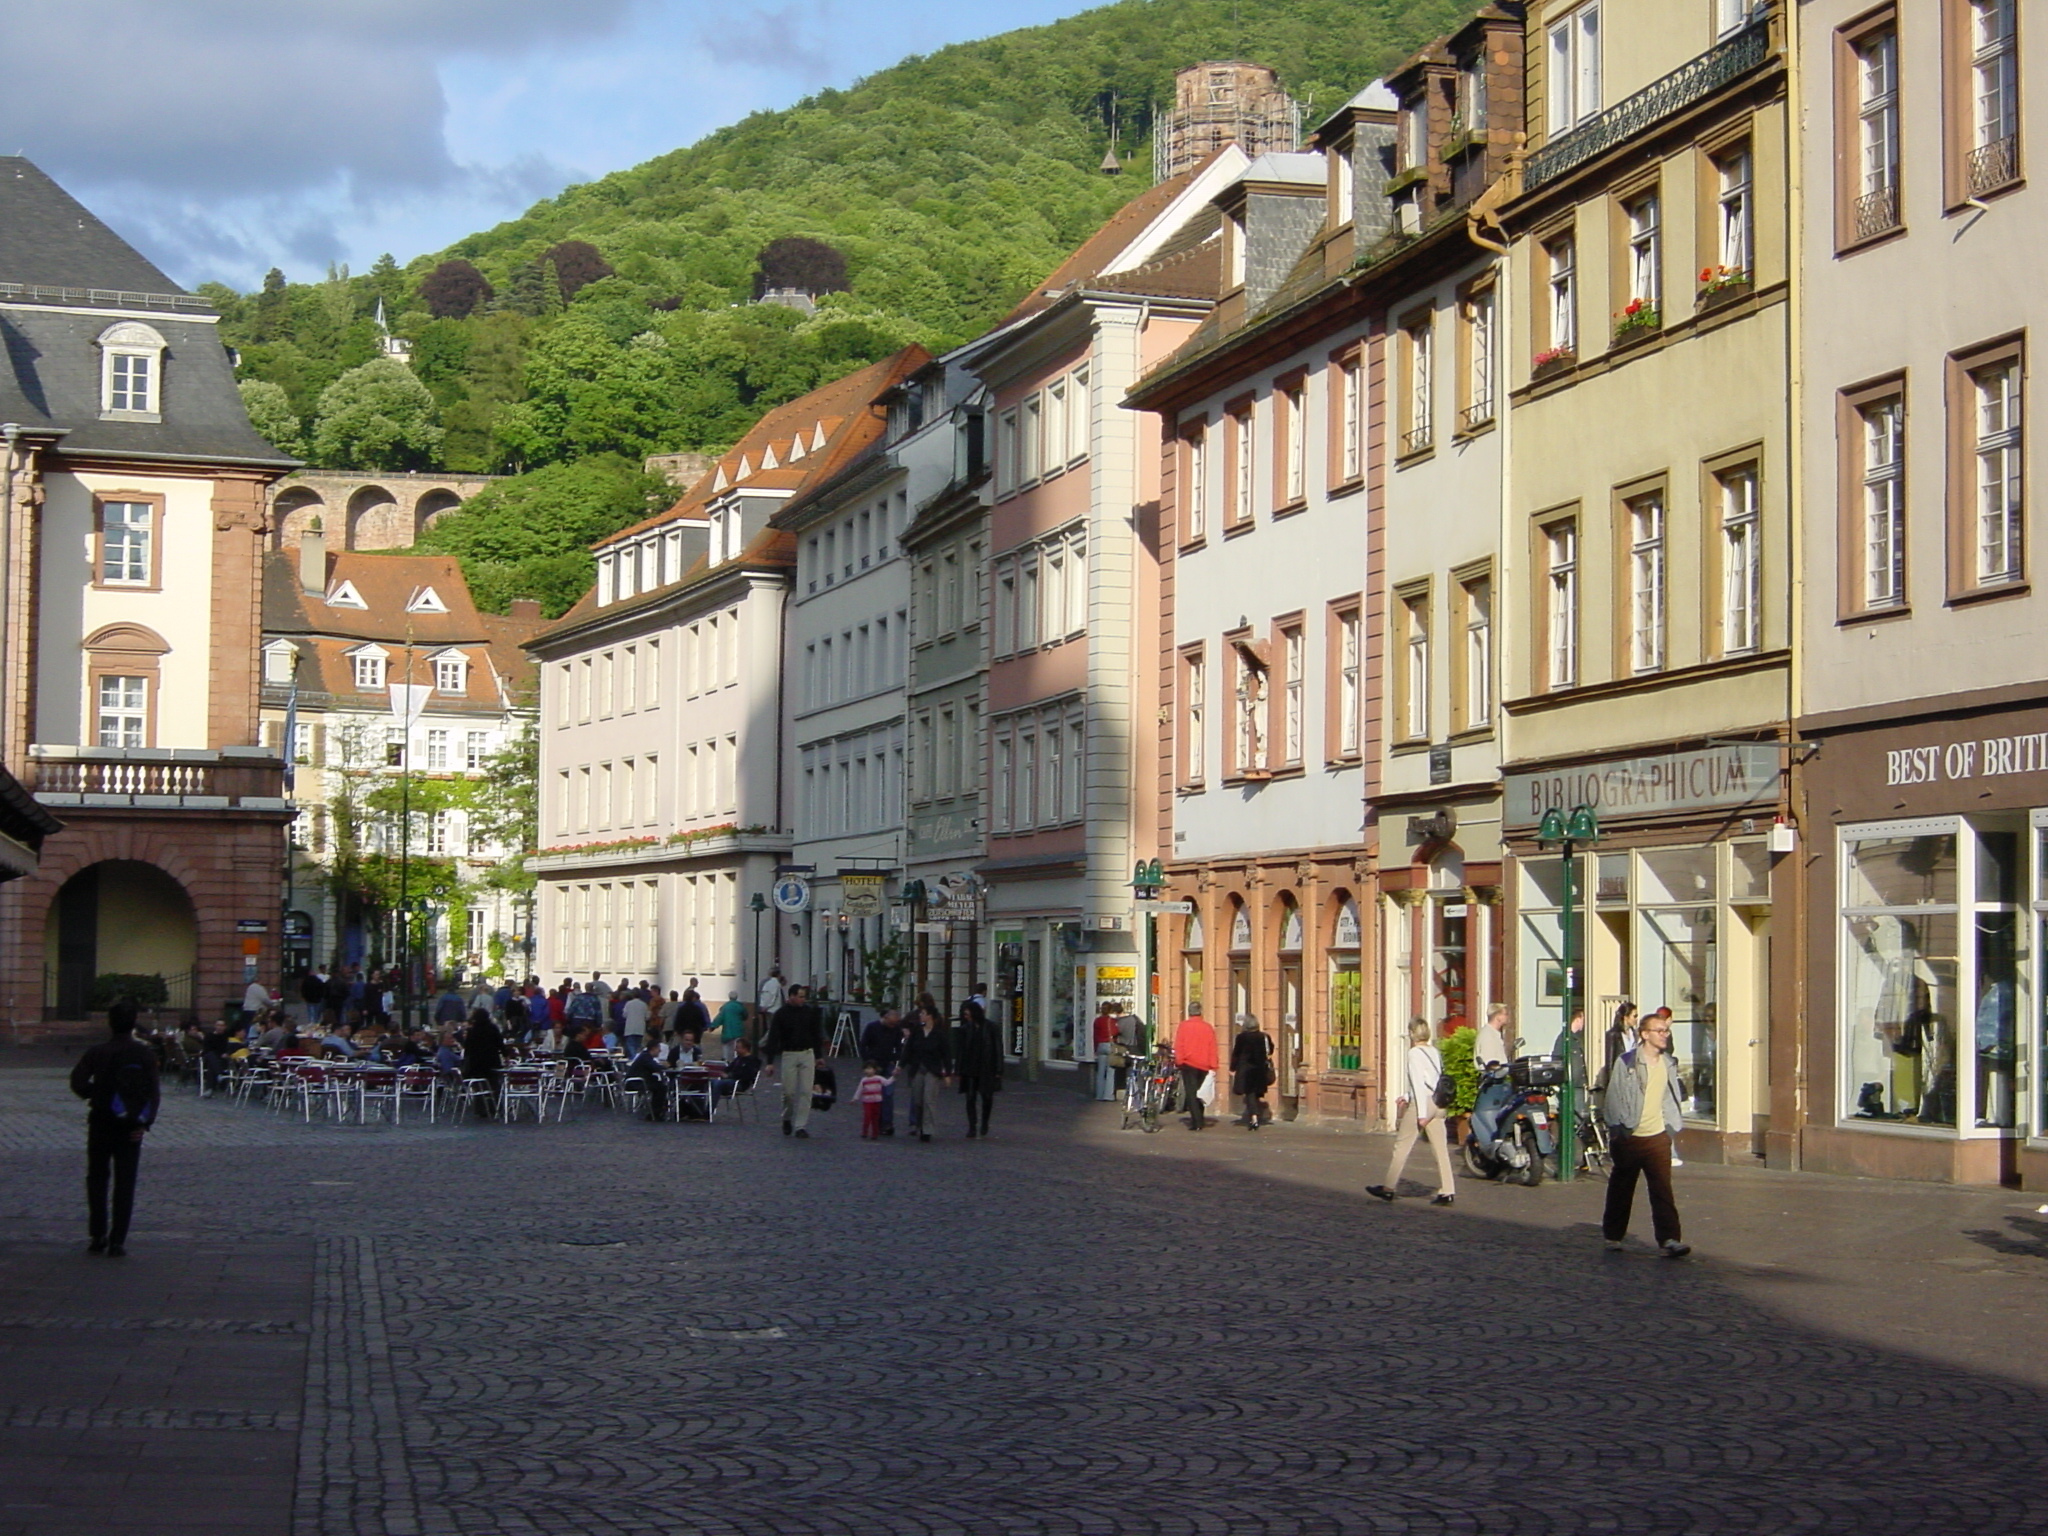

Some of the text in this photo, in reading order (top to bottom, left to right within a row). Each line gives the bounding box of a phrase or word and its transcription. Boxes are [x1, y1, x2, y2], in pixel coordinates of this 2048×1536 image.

[1886, 732, 2048, 786] BEST OF BRITI
[1530, 755, 1749, 817] BIBLIOGRAPHICUM
[845, 877, 881, 886] HOTEL
[1015, 964, 1024, 992] Presse
[1014, 1025, 1023, 1053] Presse
